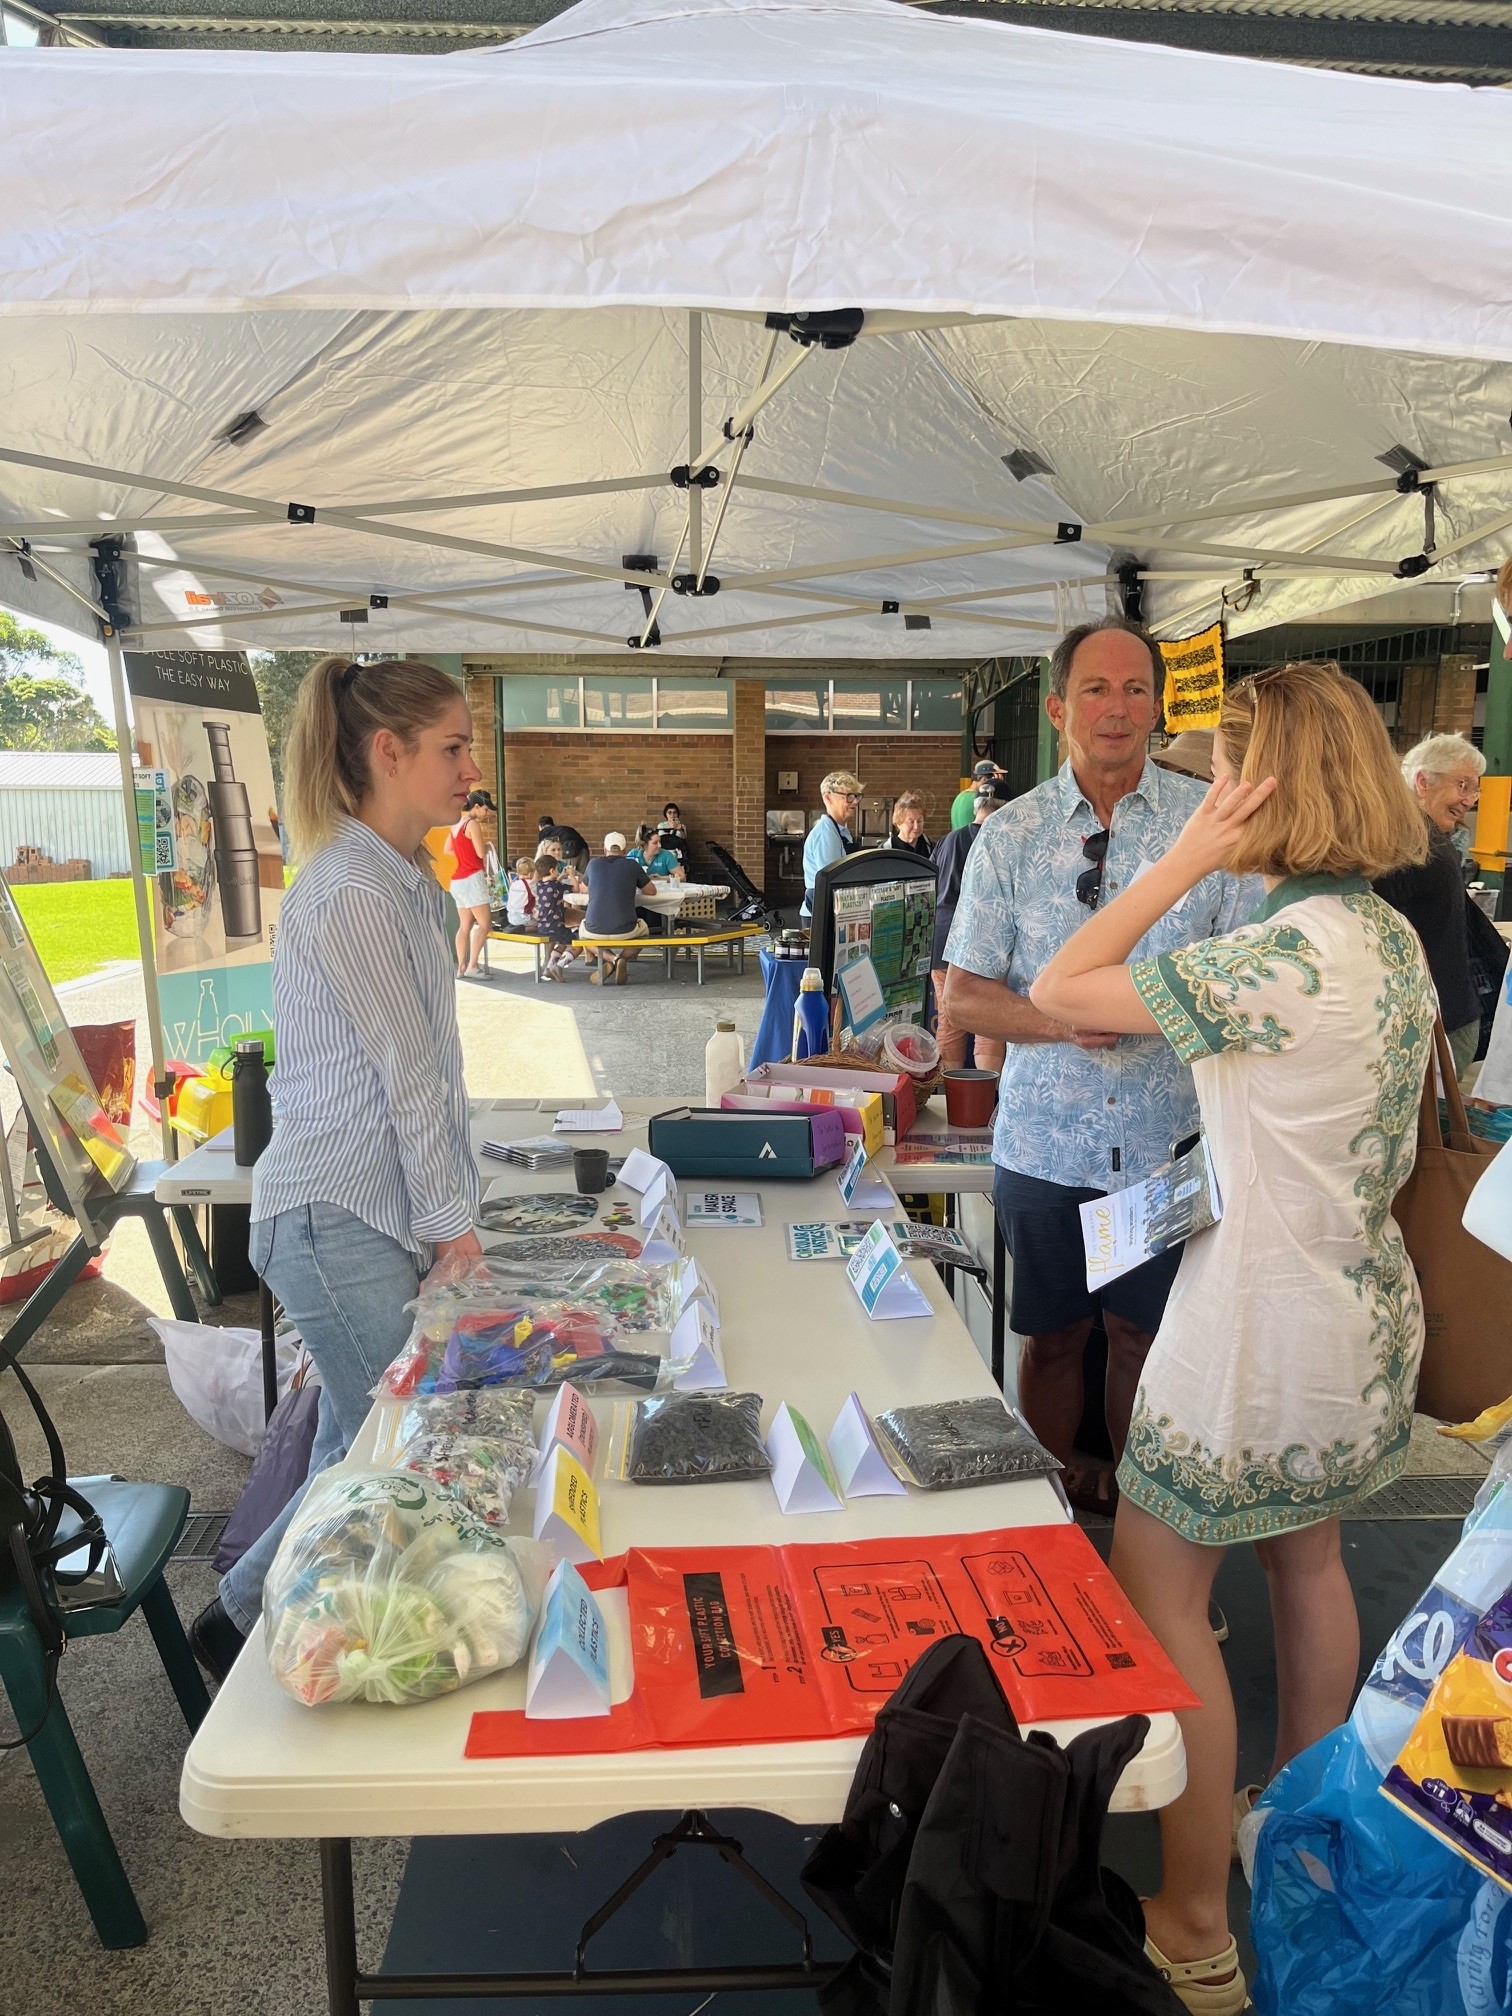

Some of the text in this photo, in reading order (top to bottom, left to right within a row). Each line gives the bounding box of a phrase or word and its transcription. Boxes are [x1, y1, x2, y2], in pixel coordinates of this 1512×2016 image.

[179, 651, 205, 667] SOFT
[208, 657, 248, 675] PLASTIC
[155, 665, 231, 692] THE EASY WAY
[704, 1193, 720, 1213] MAKER
[721, 1195, 737, 1213] SPACE
[794, 1231, 813, 1258] CIRCULAR
[810, 1230, 828, 1254] PLASTICS
[1088, 1206, 1125, 1273] flame
[566, 1393, 579, 1440] AGGLOMERATED
[579, 1489, 588, 1527] PLASTICS
[579, 1598, 588, 1652] COLLECTED
[693, 1597, 708, 1627] PLASTIC
[590, 1617, 599, 1665] PLASTICS
[829, 1629, 841, 1644] YES
[702, 1642, 716, 1670] YOUR
[786, 1666, 803, 1674] 2
[1462, 1943, 1492, 2010] Caring
